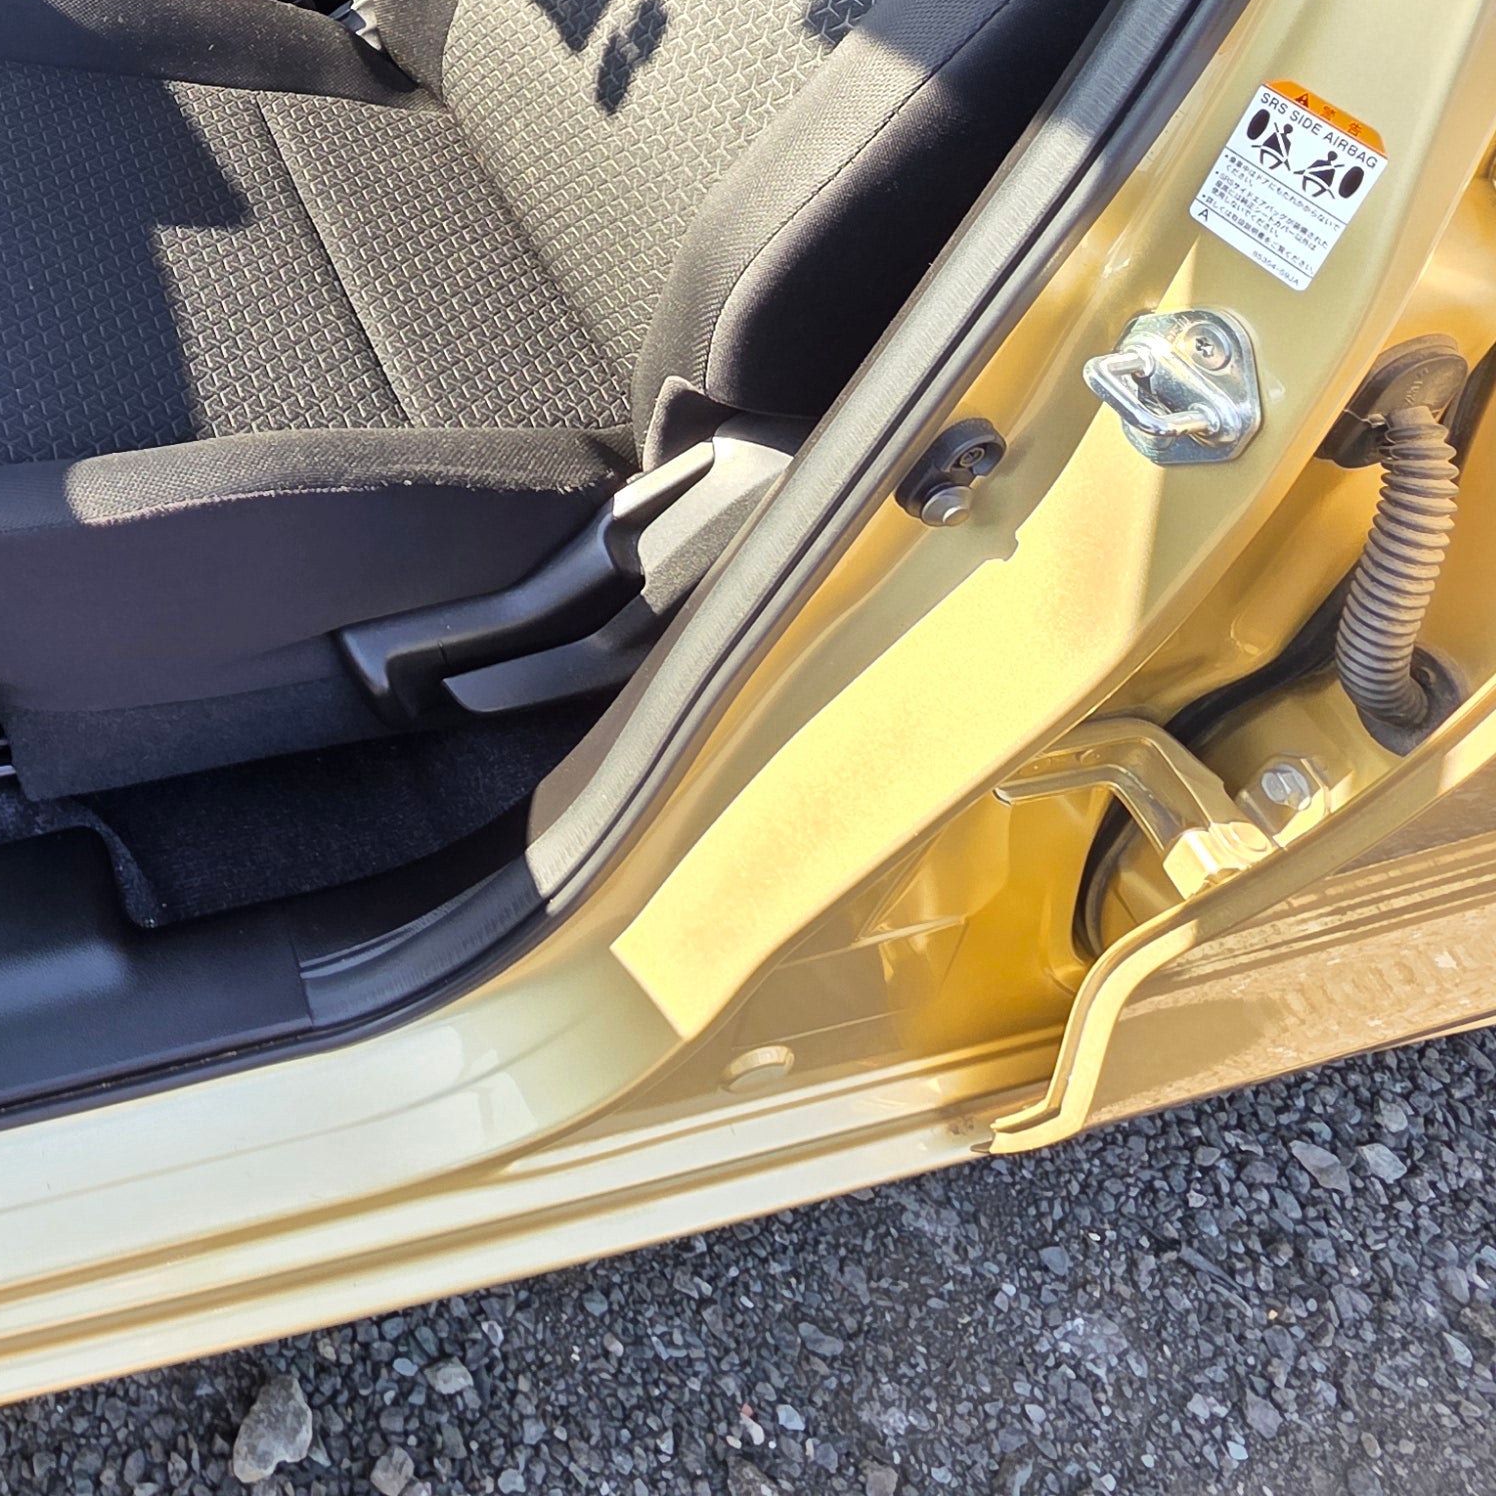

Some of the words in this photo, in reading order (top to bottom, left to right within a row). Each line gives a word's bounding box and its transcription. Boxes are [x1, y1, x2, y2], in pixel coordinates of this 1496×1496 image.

[1260, 92, 1288, 115] SRS
[1289, 109, 1323, 136] SIDE
[1322, 131, 1379, 170] AIRBAG
[1198, 208, 1210, 222] A
